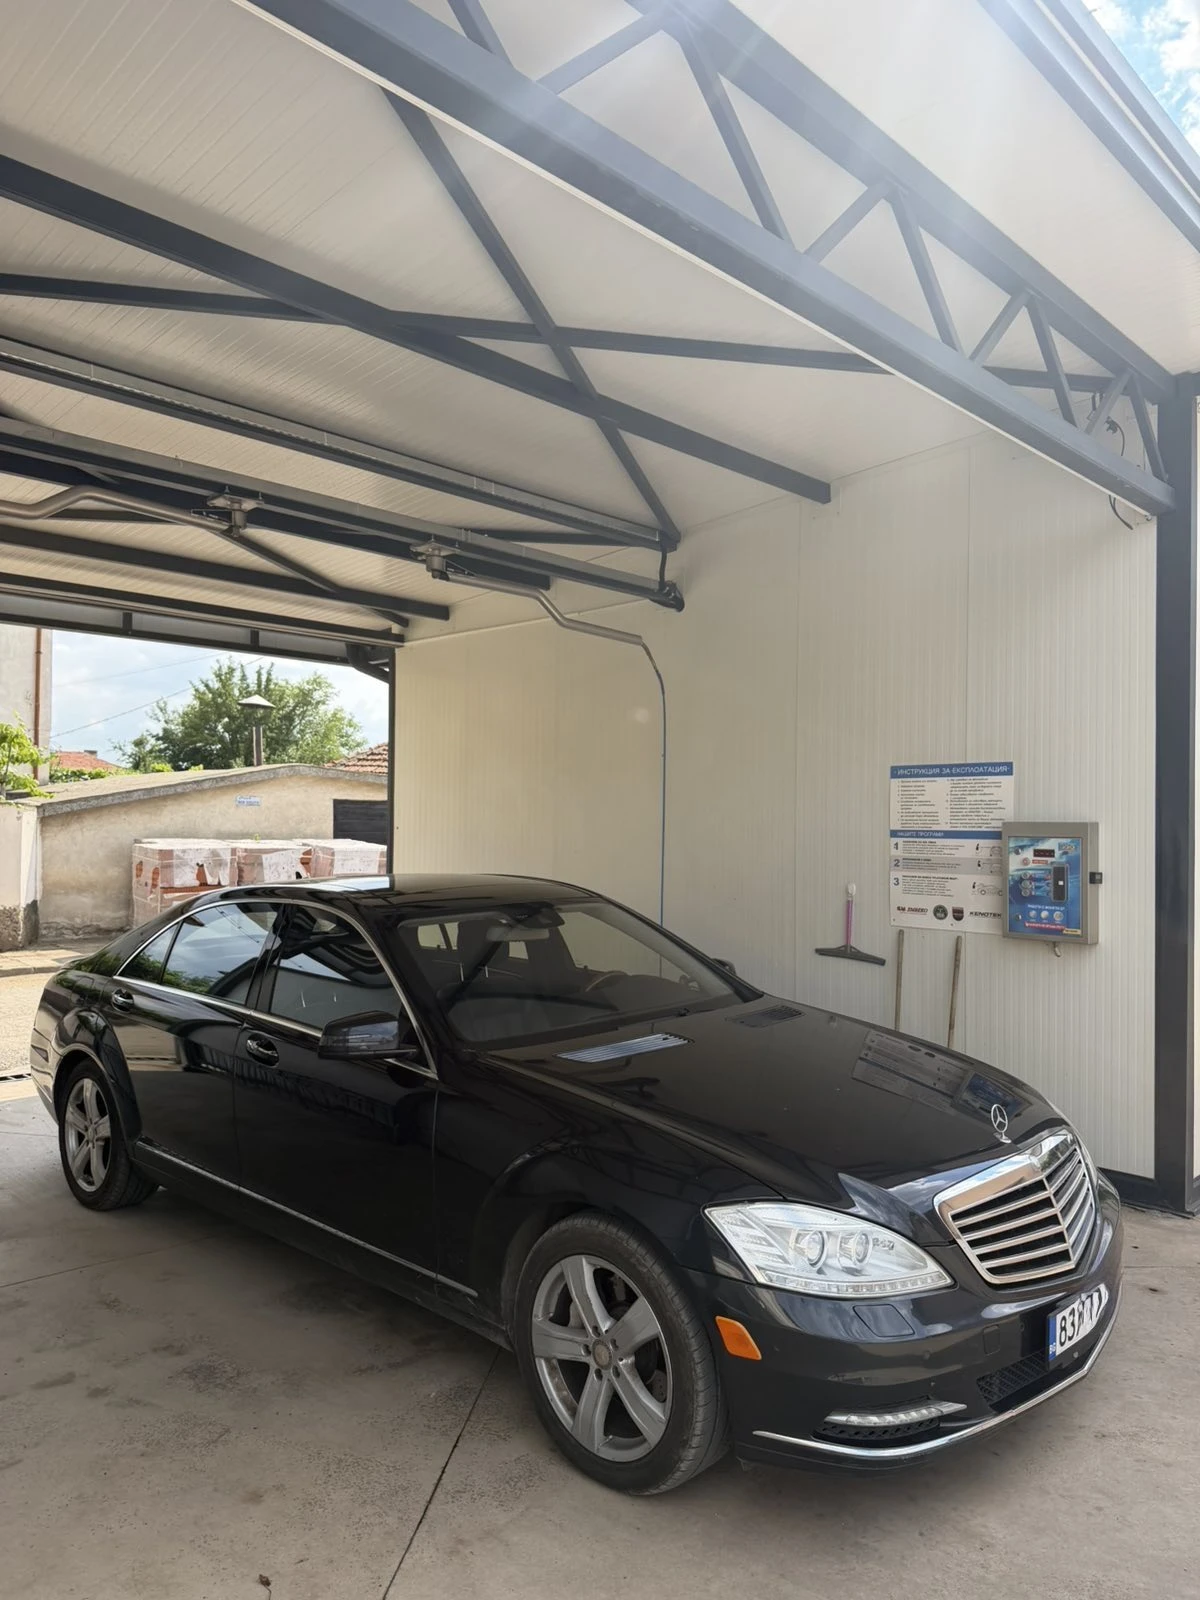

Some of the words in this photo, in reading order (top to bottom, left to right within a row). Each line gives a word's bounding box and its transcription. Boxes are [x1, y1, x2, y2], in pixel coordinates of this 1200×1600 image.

[897, 767, 940, 775] ИНСТРУКЦИЯ
[952, 765, 1008, 773] ЕКСПЛОАТАЦИЯ
[893, 858, 900, 867] 2
[893, 877, 900, 886] 3
